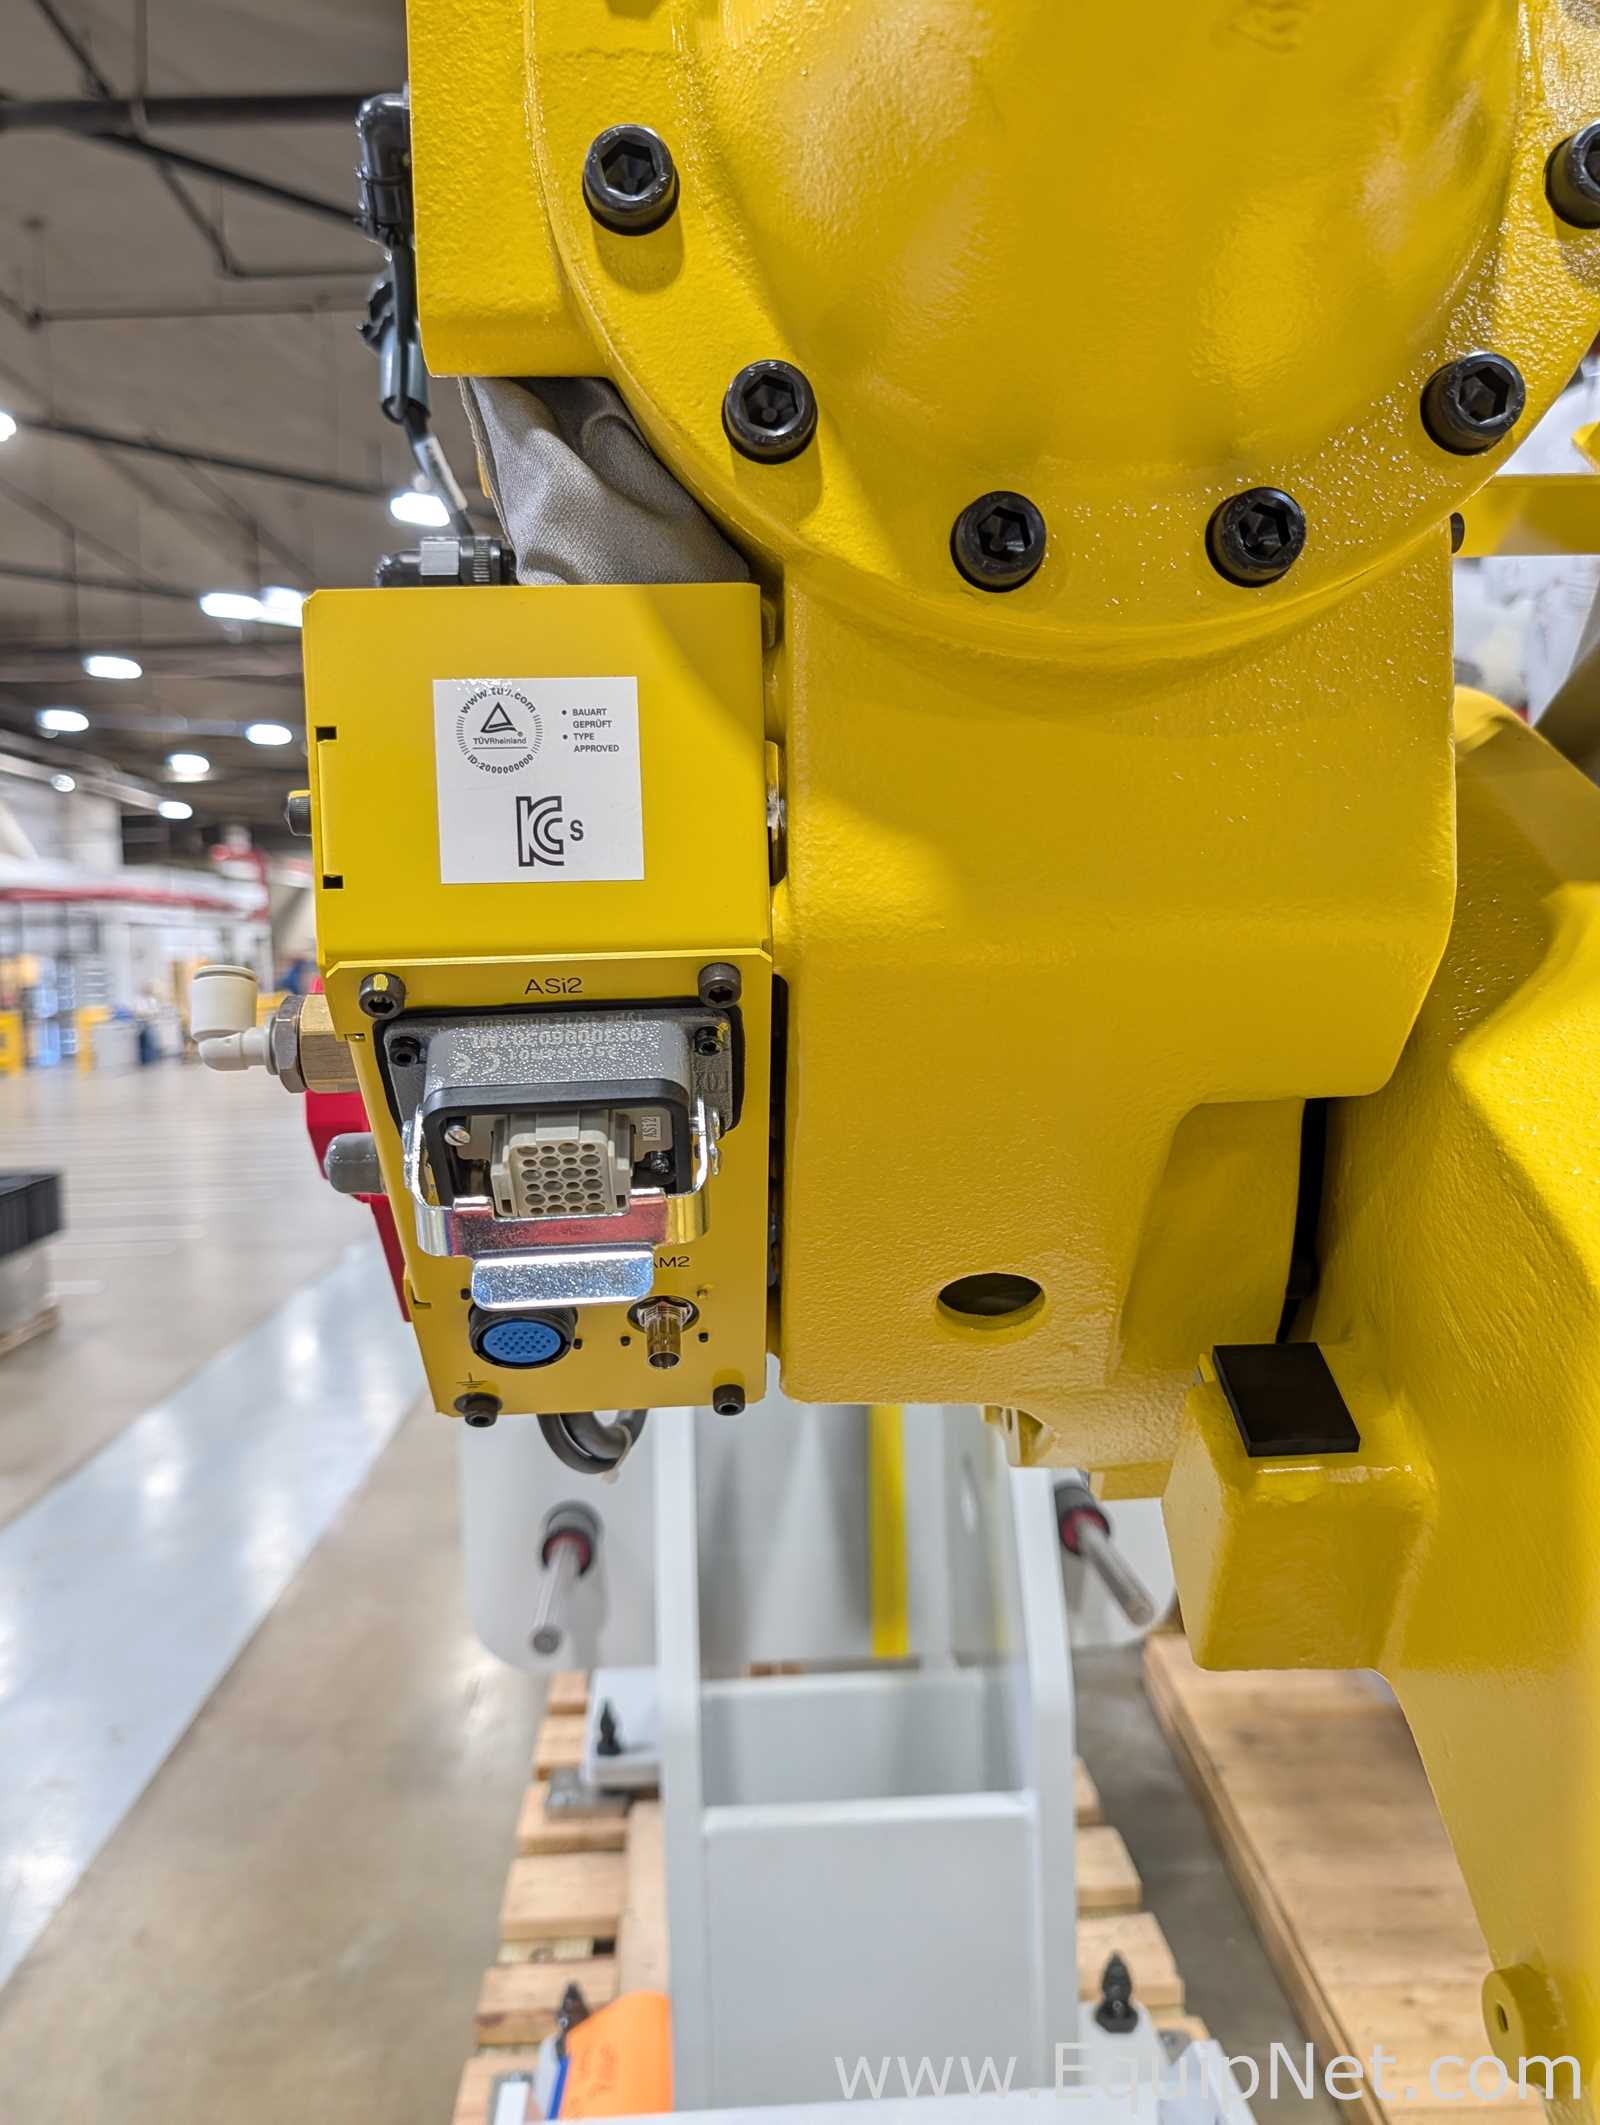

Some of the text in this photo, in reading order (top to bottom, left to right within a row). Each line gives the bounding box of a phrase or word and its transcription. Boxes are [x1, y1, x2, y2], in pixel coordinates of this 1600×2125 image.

[572, 708, 607, 716] BAUART
[573, 719, 612, 729] GEPRÜFT
[524, 977, 583, 995] ASi2
[653, 1255, 691, 1269] M2
